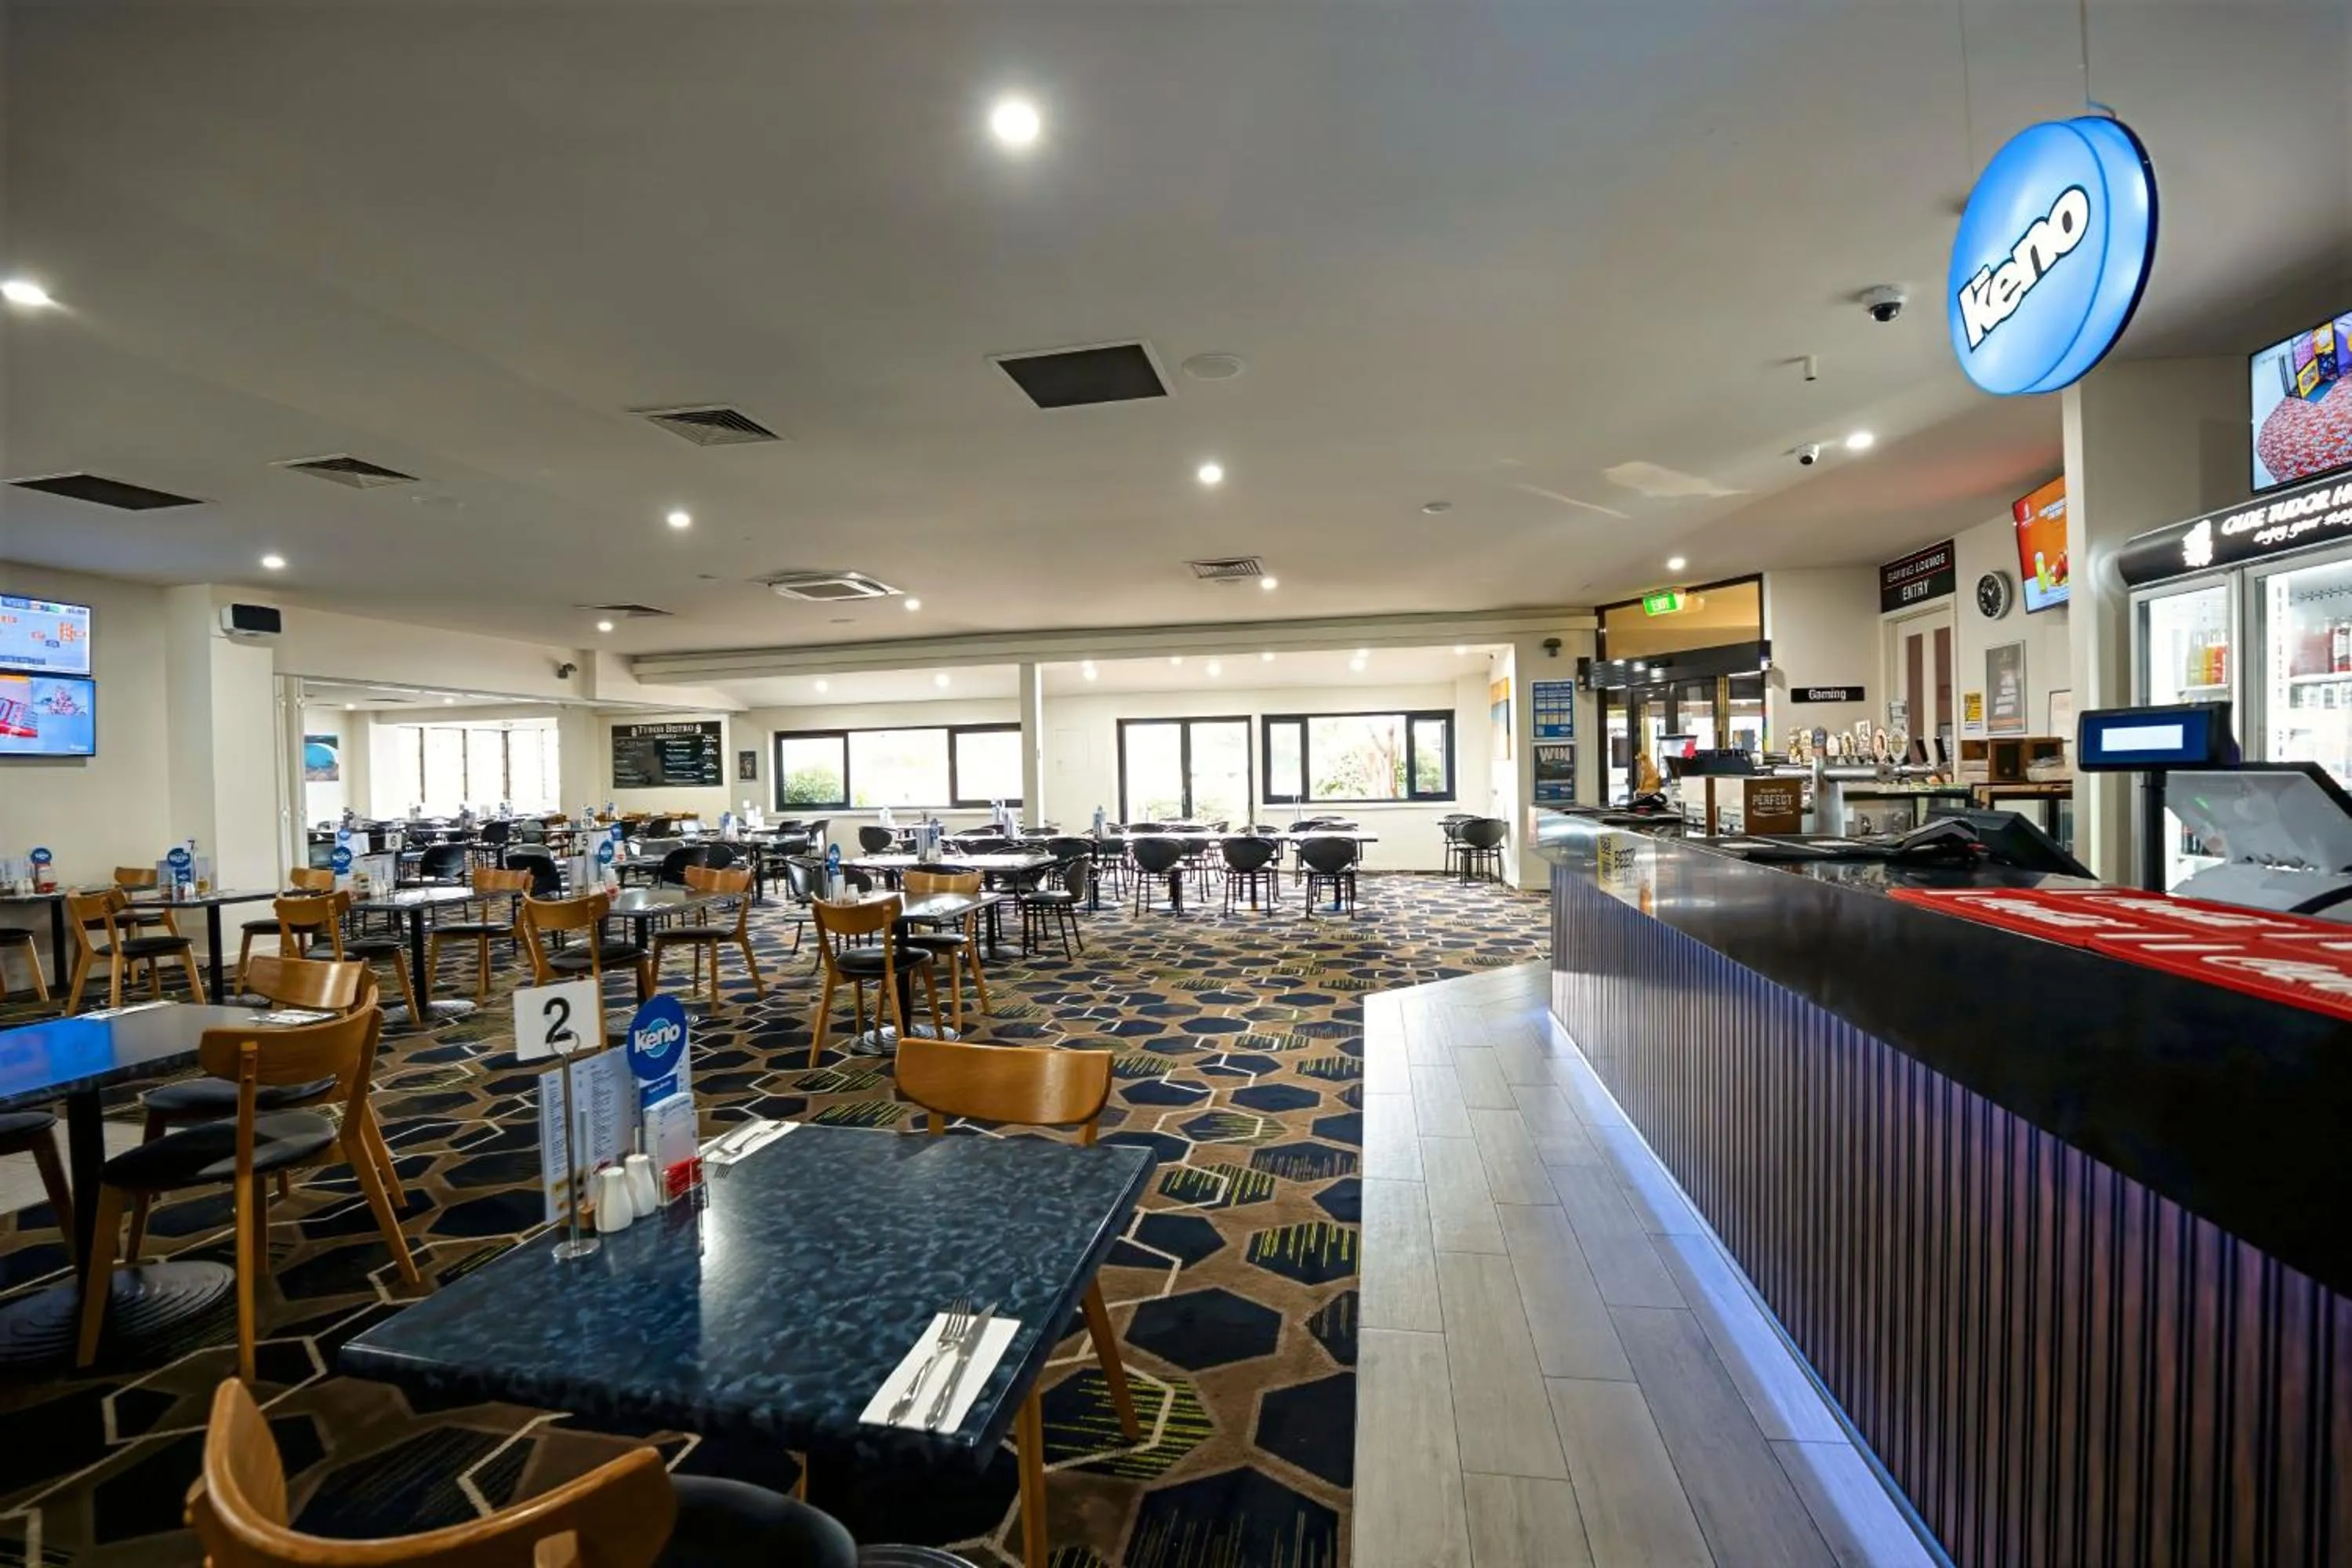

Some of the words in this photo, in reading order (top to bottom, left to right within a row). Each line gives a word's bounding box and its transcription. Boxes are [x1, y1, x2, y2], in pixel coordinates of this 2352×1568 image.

[1958, 183, 2091, 354] Keno
[2221, 506, 2267, 535] OLDE
[2268, 489, 2331, 523] TUDOR
[1915, 553, 1945, 573] LOUNGE
[1903, 578, 1929, 601] ENTRY
[1808, 689, 1846, 701] Gaming
[1538, 747, 1570, 763] WIN
[1752, 794, 1793, 806] PERFECT
[543, 996, 571, 1044] 2
[634, 1024, 681, 1054] Keno
